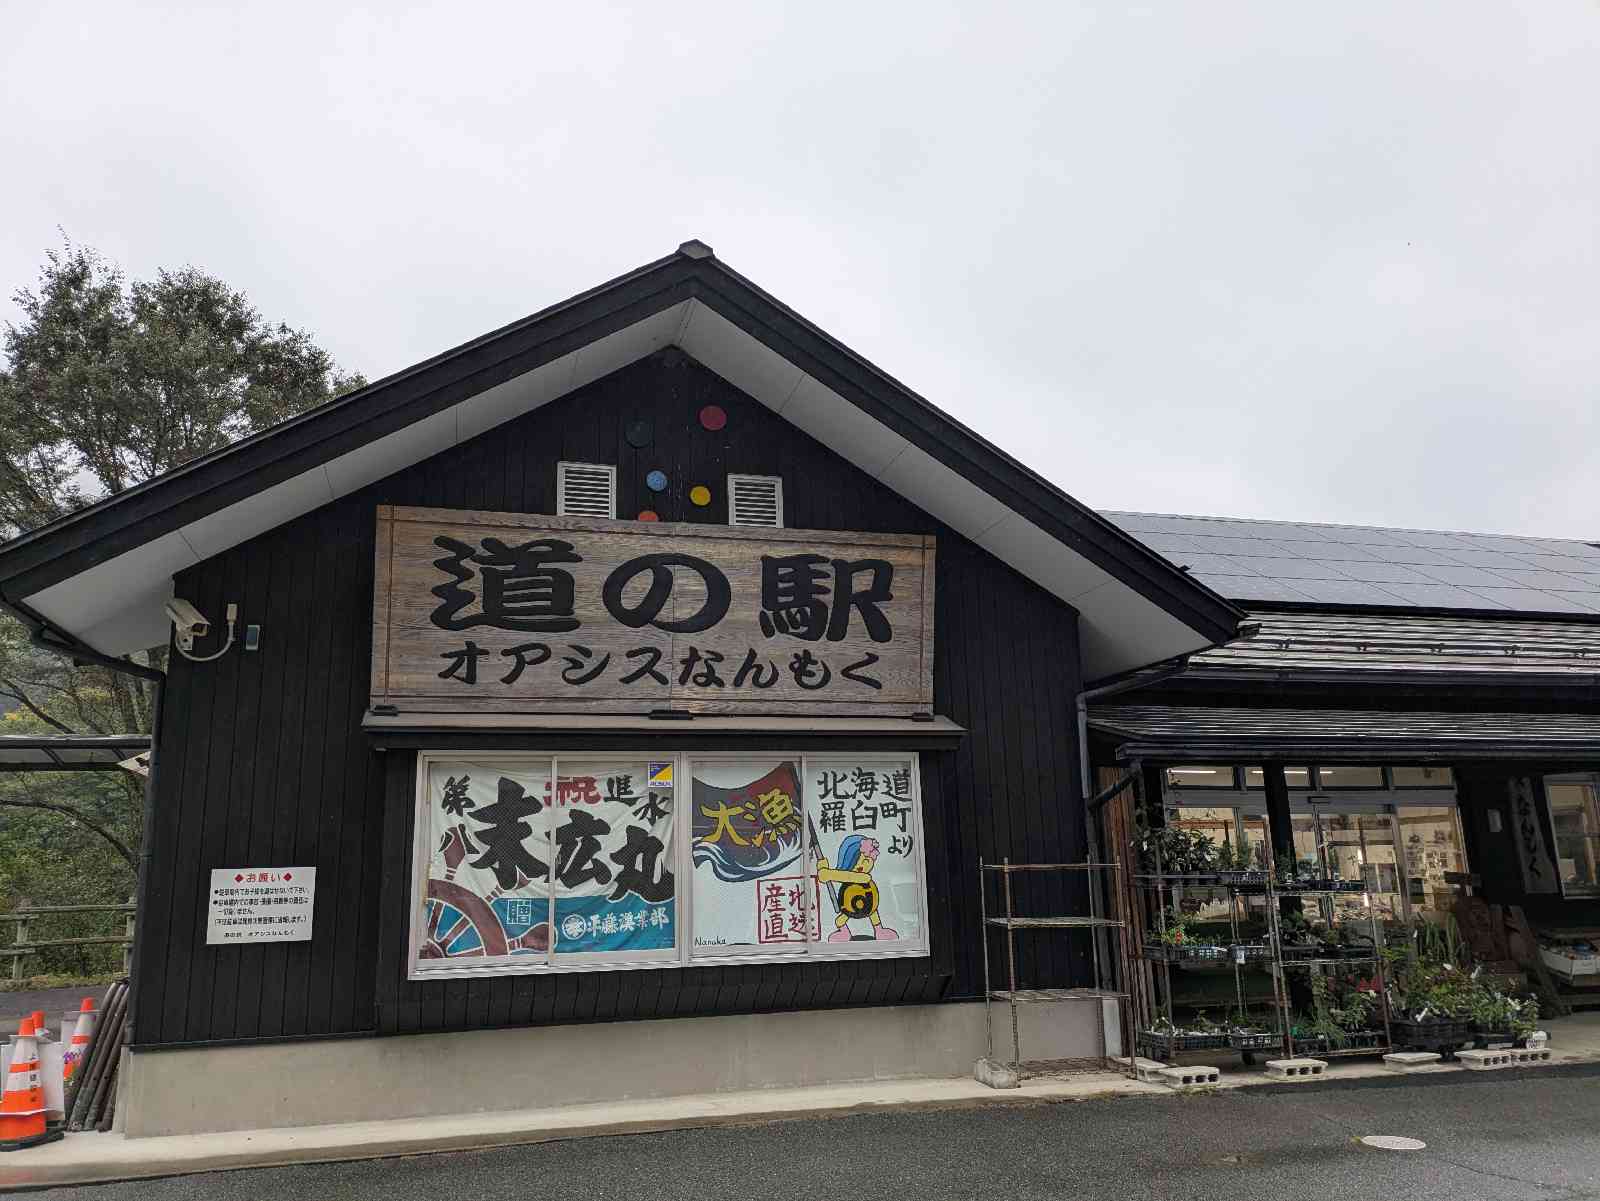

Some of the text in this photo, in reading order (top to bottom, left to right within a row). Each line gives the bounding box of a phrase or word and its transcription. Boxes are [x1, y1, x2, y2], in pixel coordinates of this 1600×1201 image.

[430, 536, 895, 642] 道の駅
[436, 641, 883, 690] オアシスなんもく
[816, 767, 913, 801] 北海道
[819, 801, 912, 833] 羅臼町
[887, 835, 914, 858] より
[246, 872, 281, 883] お願い
